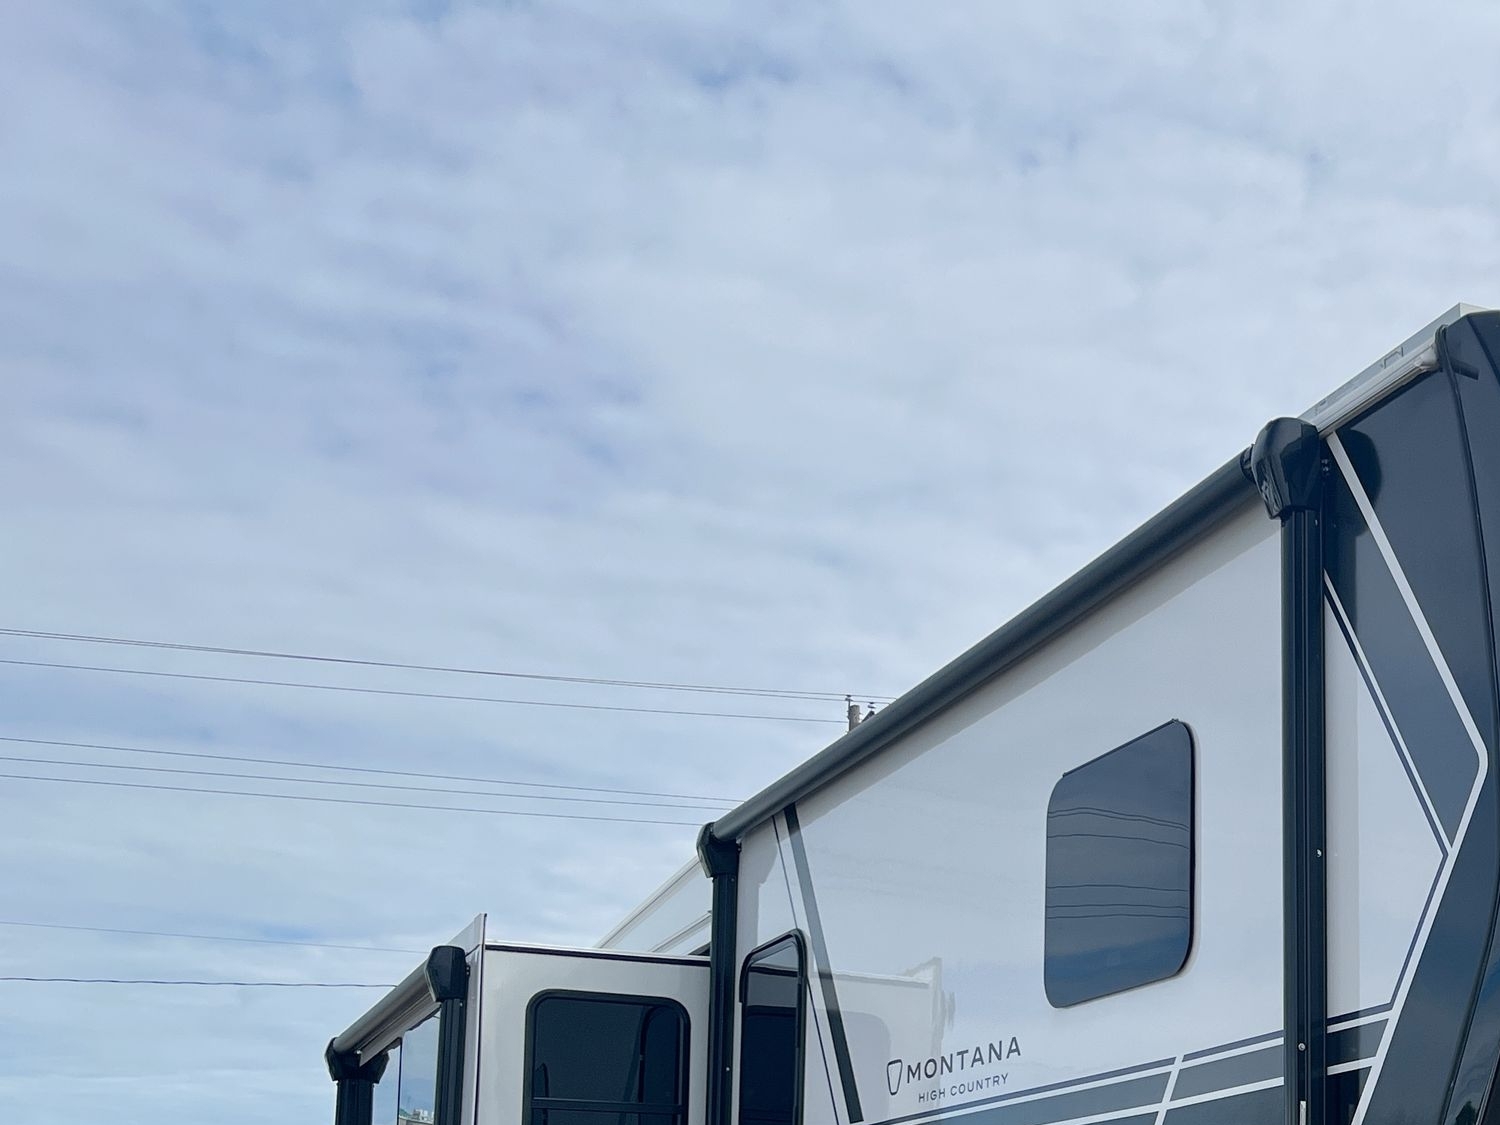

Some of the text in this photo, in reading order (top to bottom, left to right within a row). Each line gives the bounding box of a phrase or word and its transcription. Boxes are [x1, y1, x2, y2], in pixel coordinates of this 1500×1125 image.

[906, 1036, 1021, 1084] MONTANA
[918, 1073, 1009, 1103] HIGH COUNTRY
